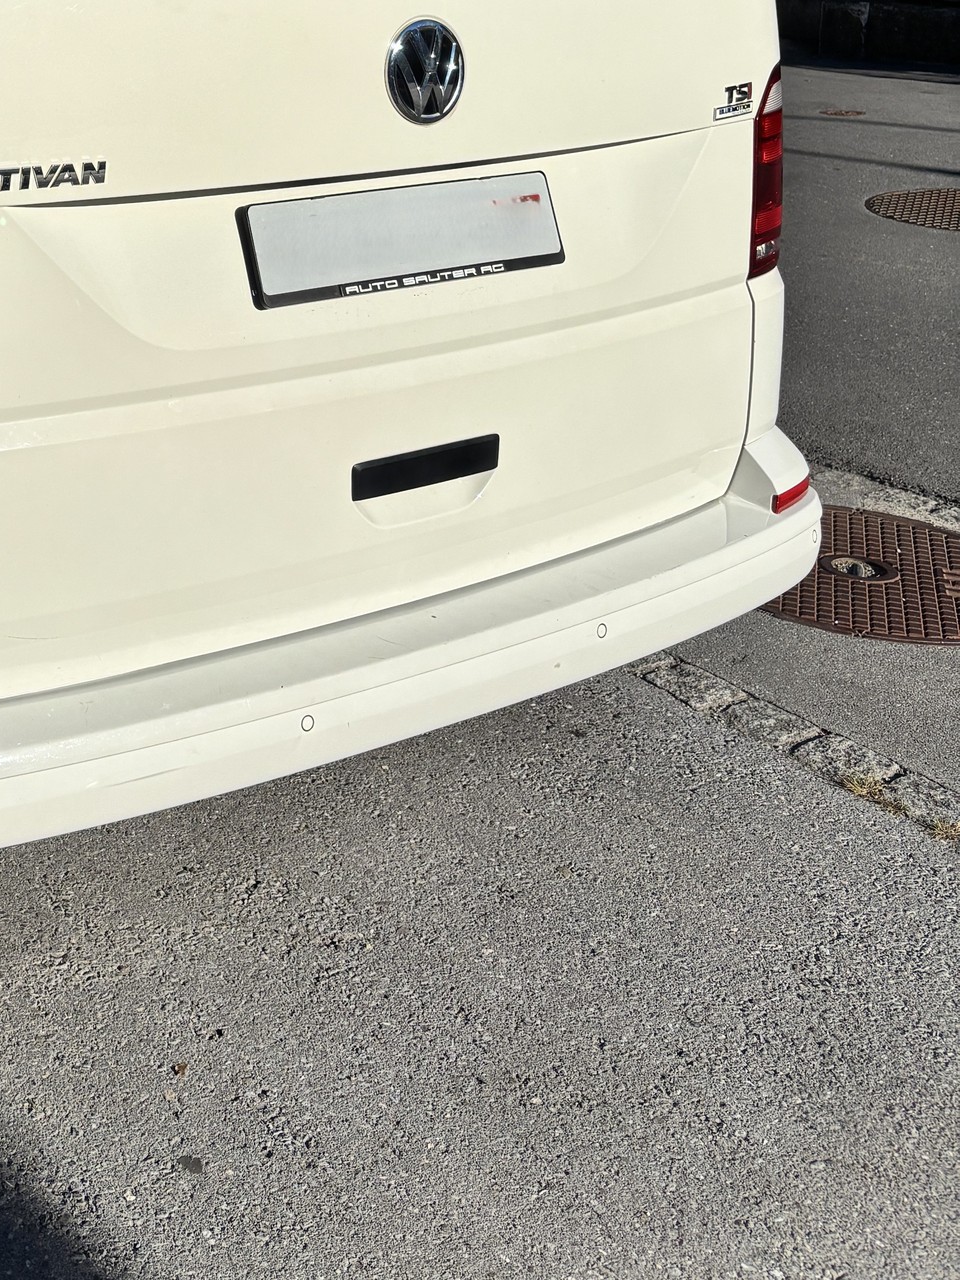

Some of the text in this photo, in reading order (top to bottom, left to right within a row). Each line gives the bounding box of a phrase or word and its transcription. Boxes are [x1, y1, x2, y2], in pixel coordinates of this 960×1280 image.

[724, 81, 752, 104] TSI
[345, 263, 505, 295] AUTO SAUTER AG
